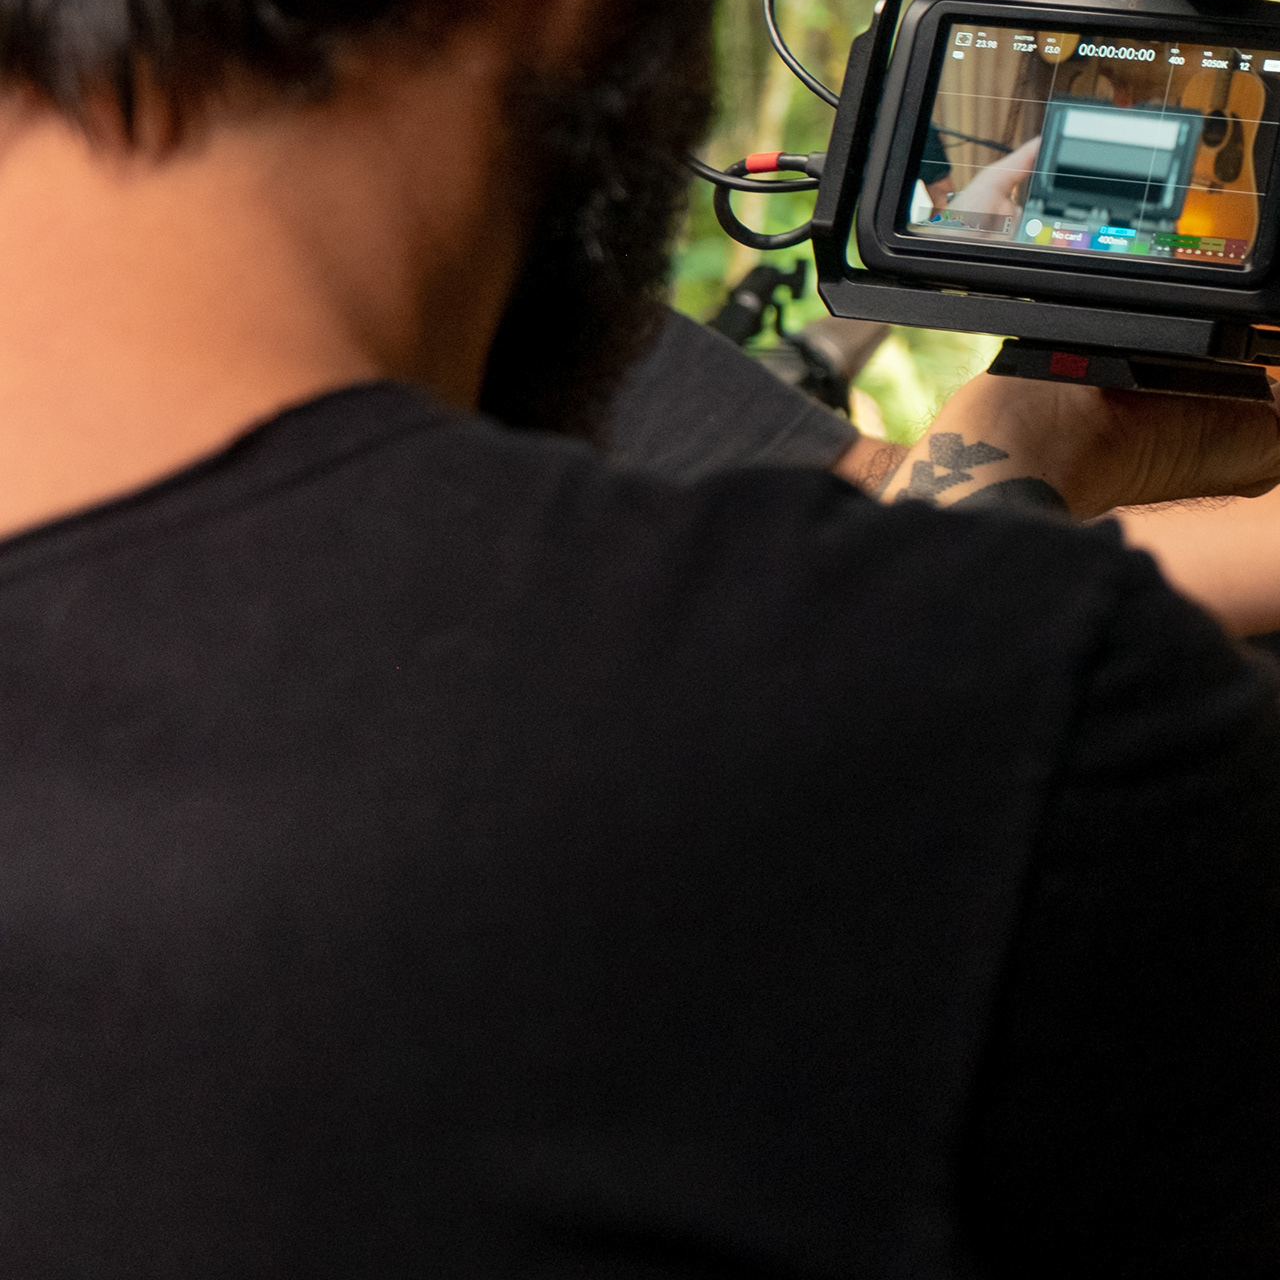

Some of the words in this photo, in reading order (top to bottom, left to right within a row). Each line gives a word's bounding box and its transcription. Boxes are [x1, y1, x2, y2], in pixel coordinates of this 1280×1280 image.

[1078, 43, 1156, 62] 00:00:00:00
[1168, 56, 1185, 66] 400
[1201, 58, 1229, 69] 5050K
[1239, 62, 1250, 71] 12
[1052, 231, 1063, 240] No
[1064, 232, 1083, 242] card
[1097, 235, 1128, 246] 400min
